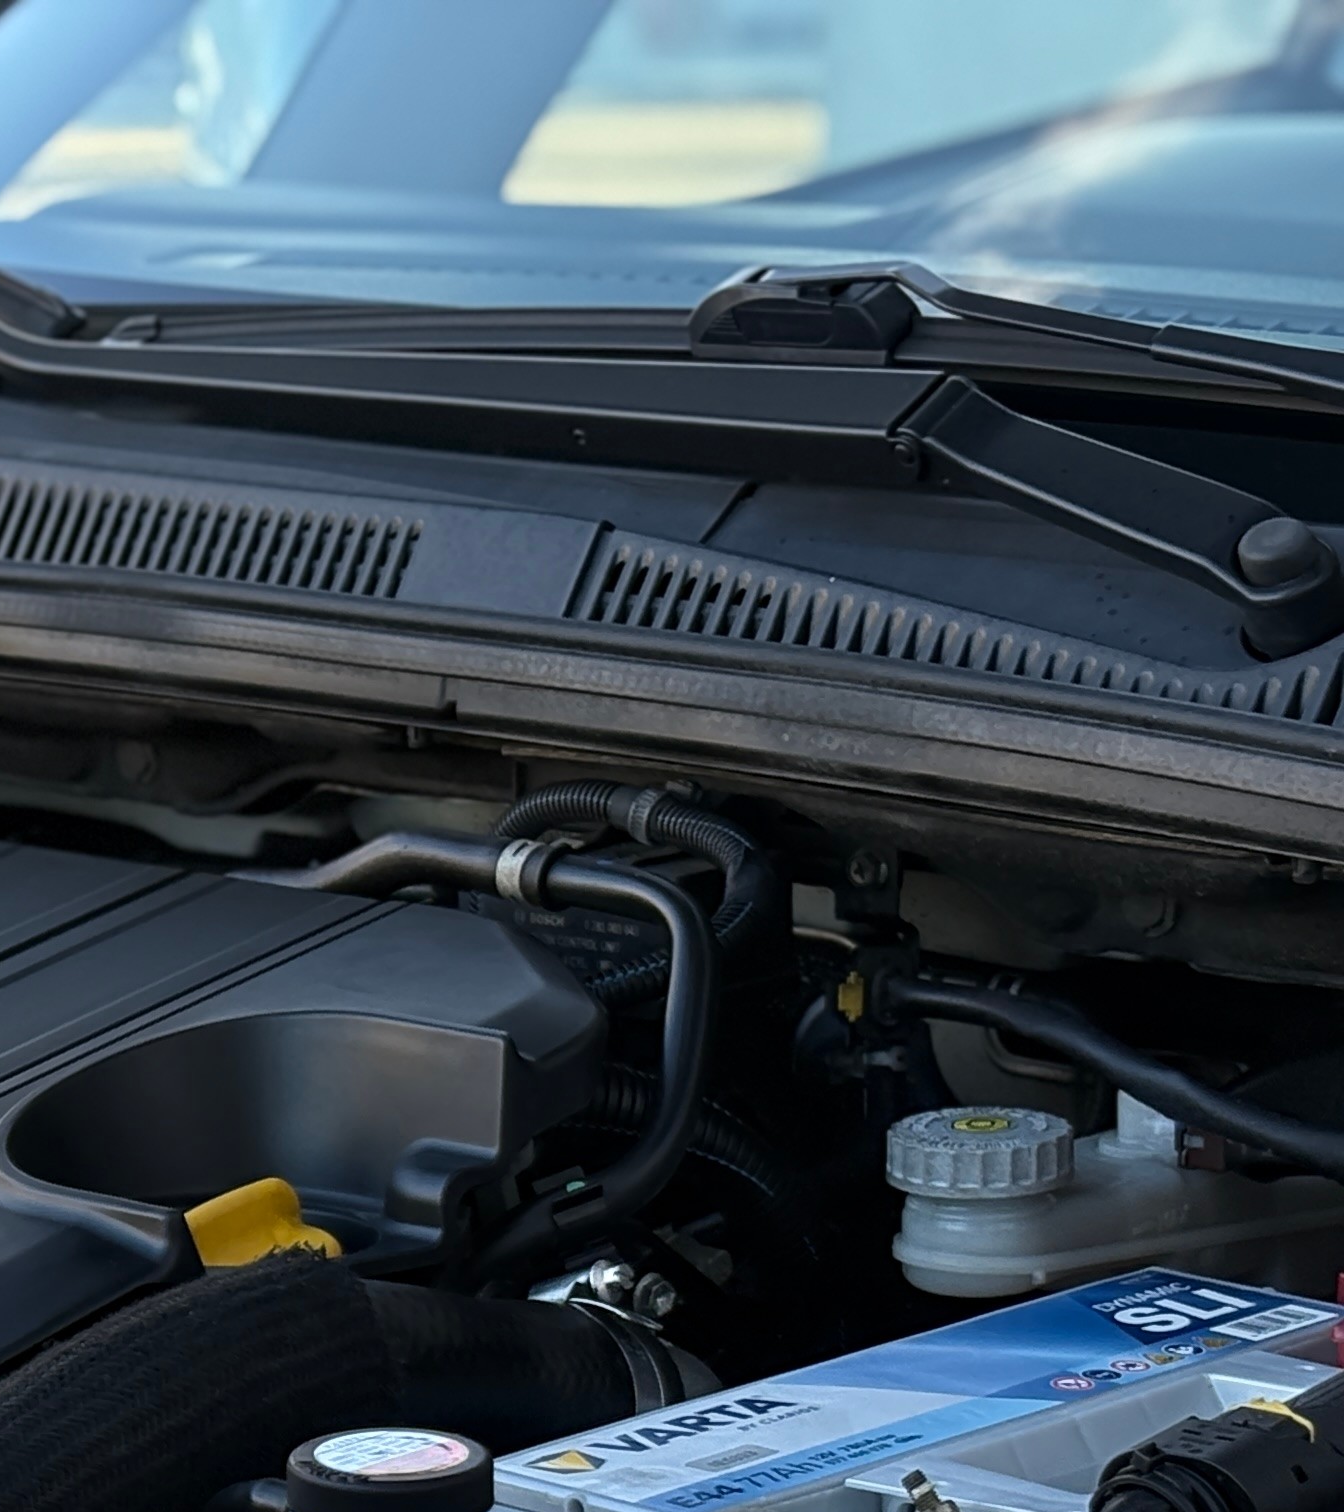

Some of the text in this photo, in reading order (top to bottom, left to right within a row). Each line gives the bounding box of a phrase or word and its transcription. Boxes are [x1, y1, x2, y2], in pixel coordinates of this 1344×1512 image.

[1091, 1282, 1193, 1313] DYNAMIC
[1113, 1288, 1257, 1333] SLI
[583, 1395, 799, 1453] VARTA
[666, 1460, 825, 1509] E44 77Ah
